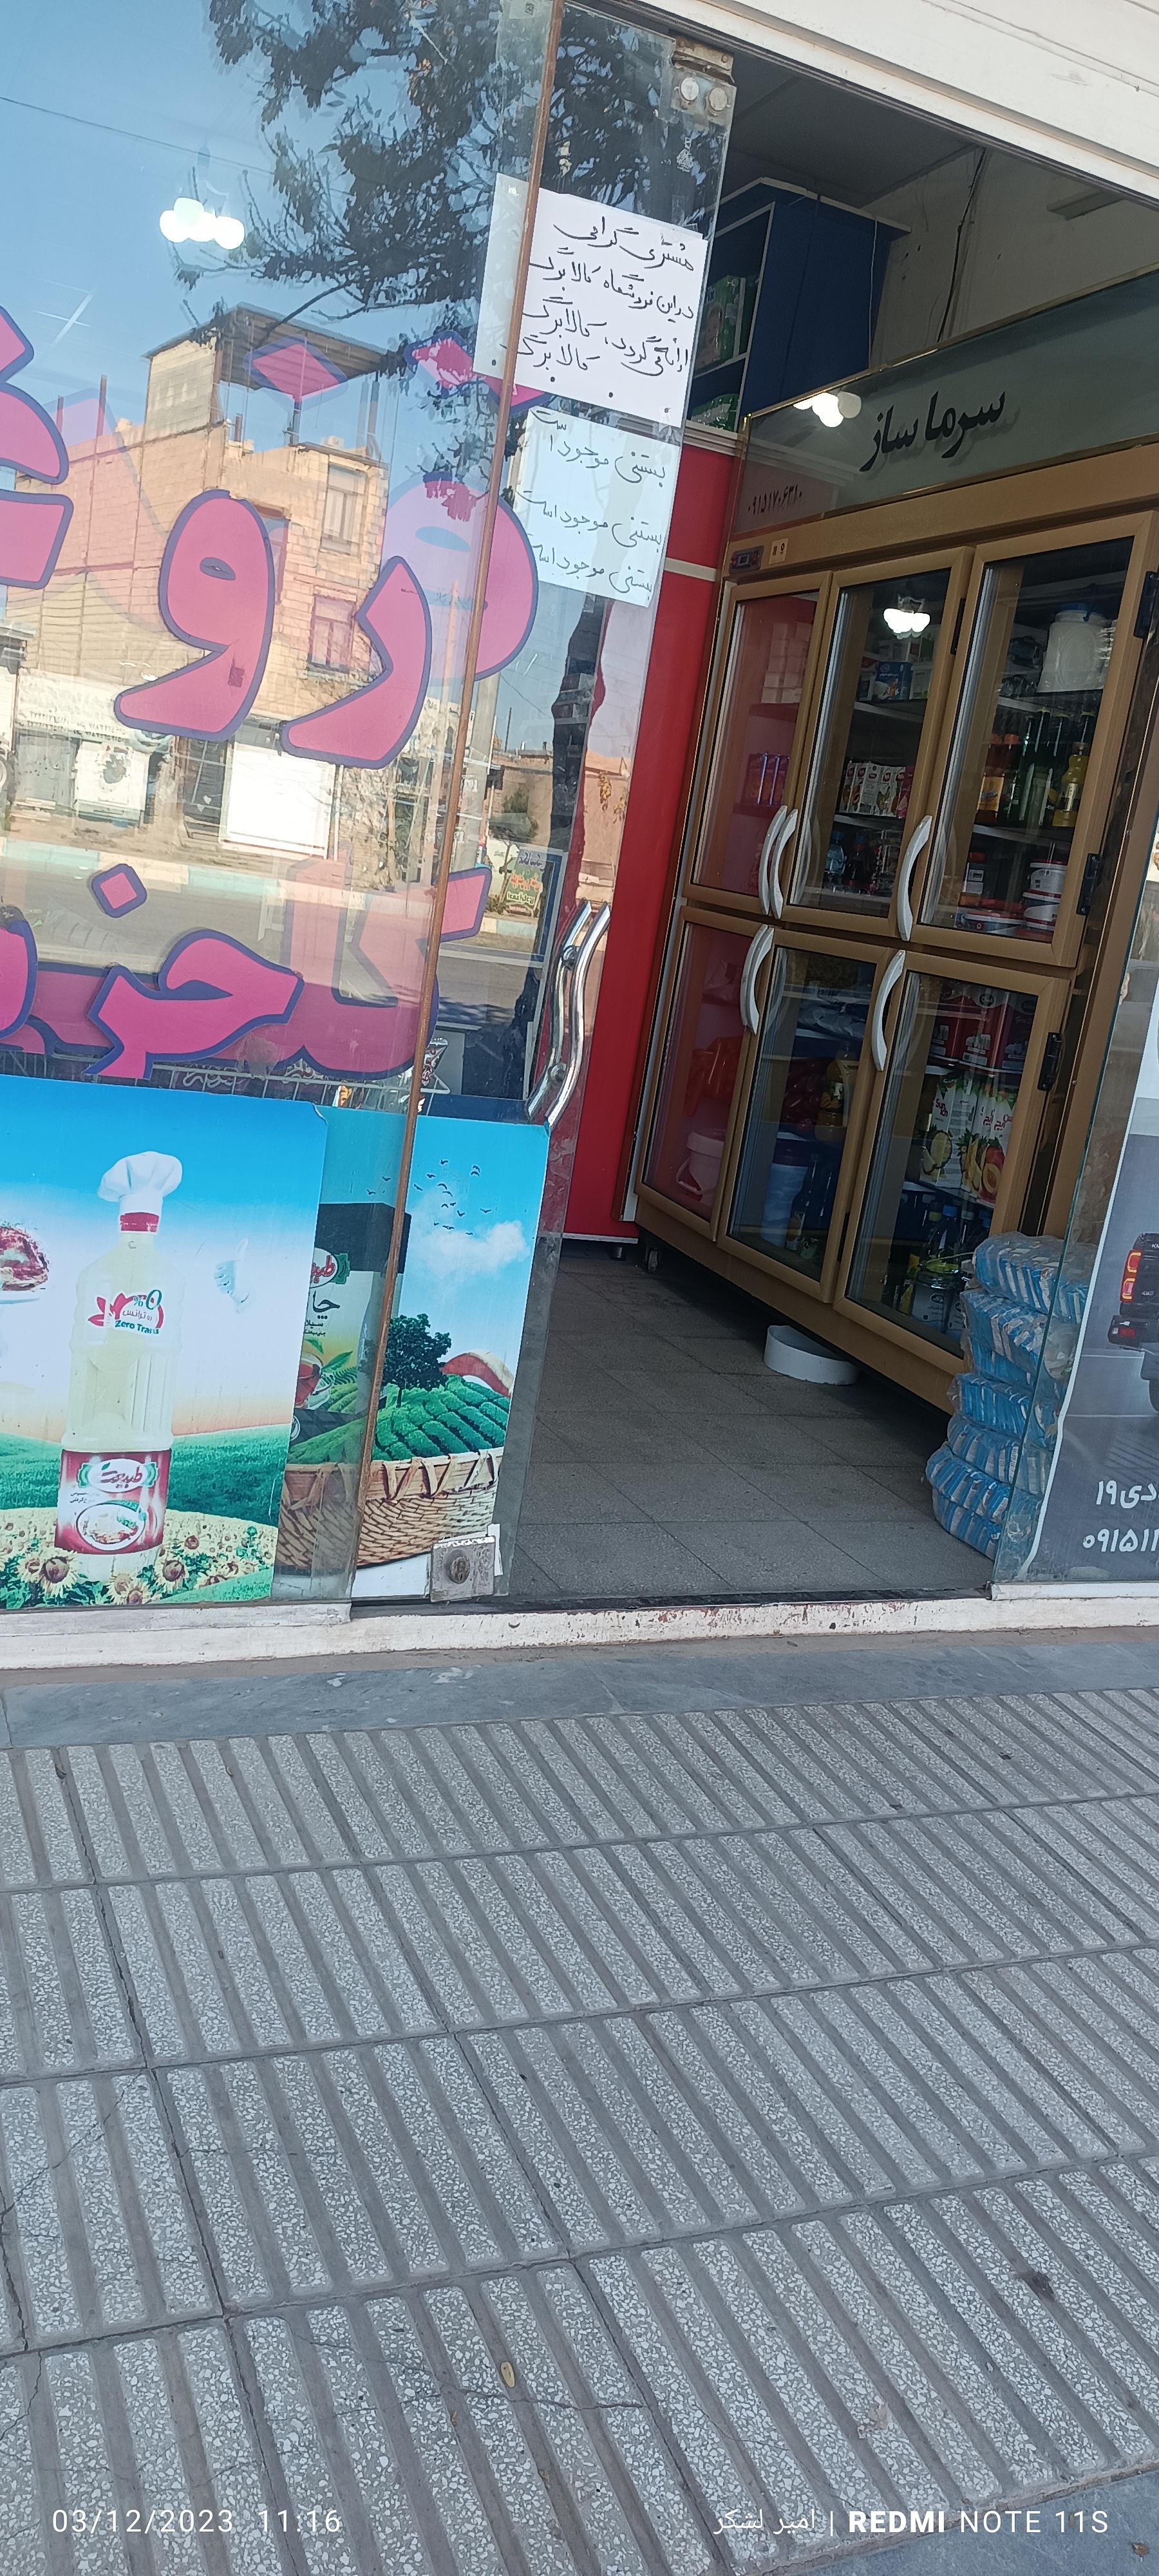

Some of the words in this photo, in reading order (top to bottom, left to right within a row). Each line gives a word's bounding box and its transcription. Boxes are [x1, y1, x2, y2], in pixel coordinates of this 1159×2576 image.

[554, 216, 639, 247] گرامی
[619, 236, 694, 271] مشتری
[860, 406, 919, 472] ساز
[925, 391, 1005, 459] سرما
[558, 441, 609, 468] موجود
[614, 451, 665, 488] بستنی
[560, 511, 608, 534] موجود
[612, 516, 662, 553] بستنی
[556, 557, 605, 580] موجود
[609, 566, 652, 601] بستنی
[115, 1320, 135, 1330] Zero
